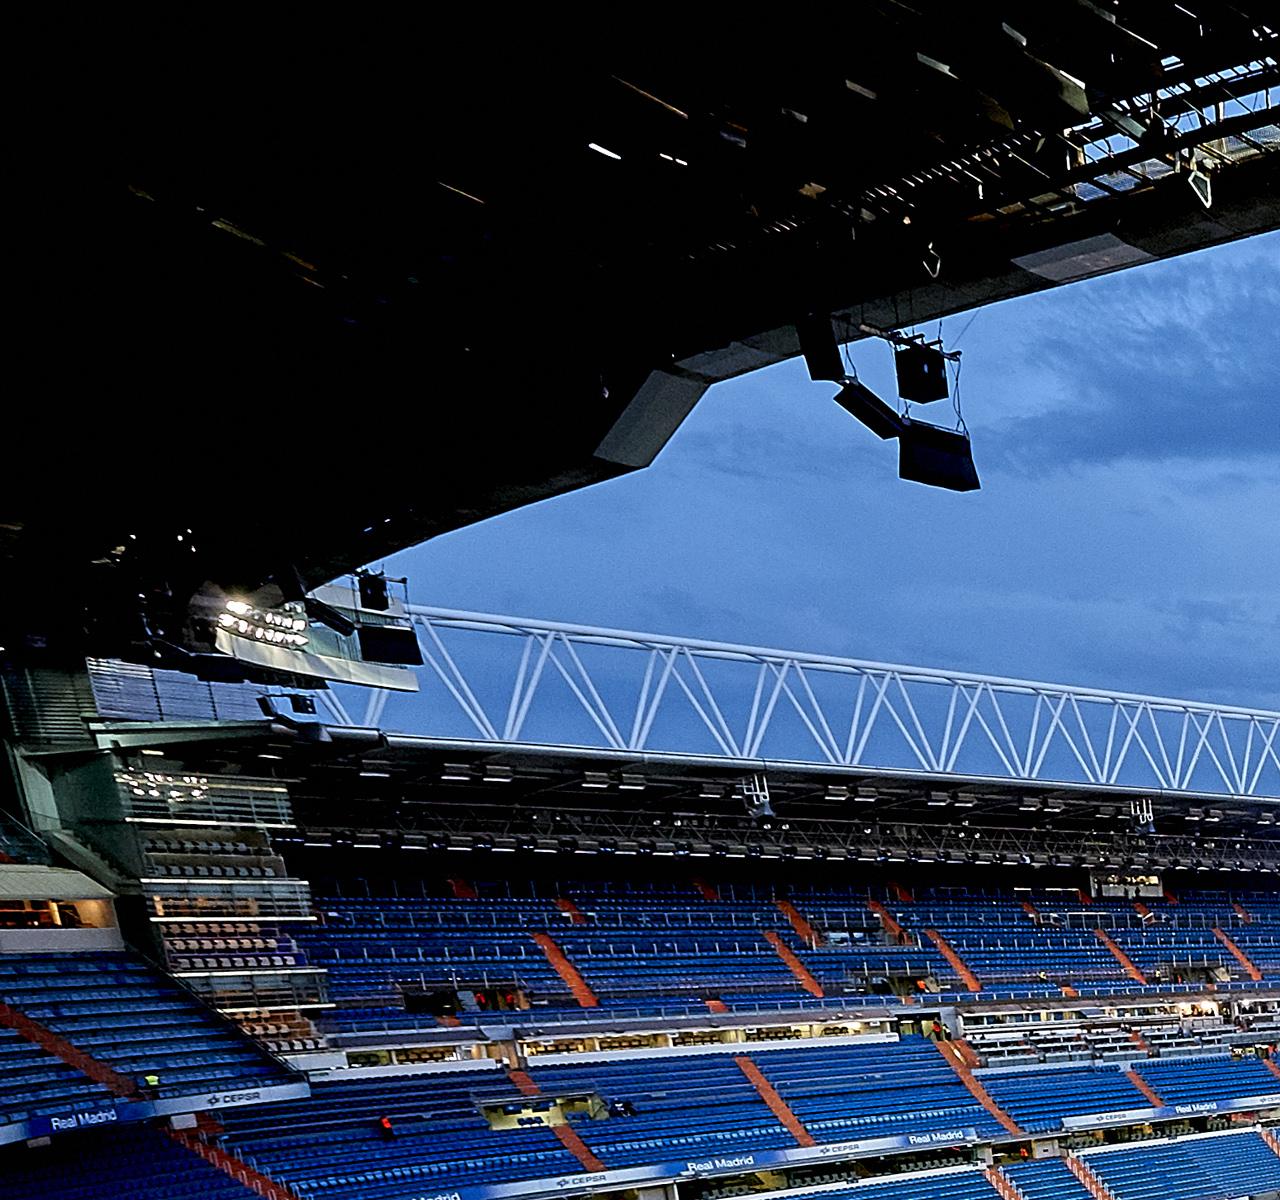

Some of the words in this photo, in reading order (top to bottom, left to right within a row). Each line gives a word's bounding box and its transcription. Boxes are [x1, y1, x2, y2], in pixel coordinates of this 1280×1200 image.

[223, 1092, 260, 1103] CEPSA
[51, 1115, 77, 1131] Real
[79, 1109, 117, 1126] Madrid
[909, 1135, 930, 1145] Real
[932, 1131, 964, 1143] Madrid
[687, 1161, 712, 1173] Real
[715, 1155, 754, 1169] Madrid
